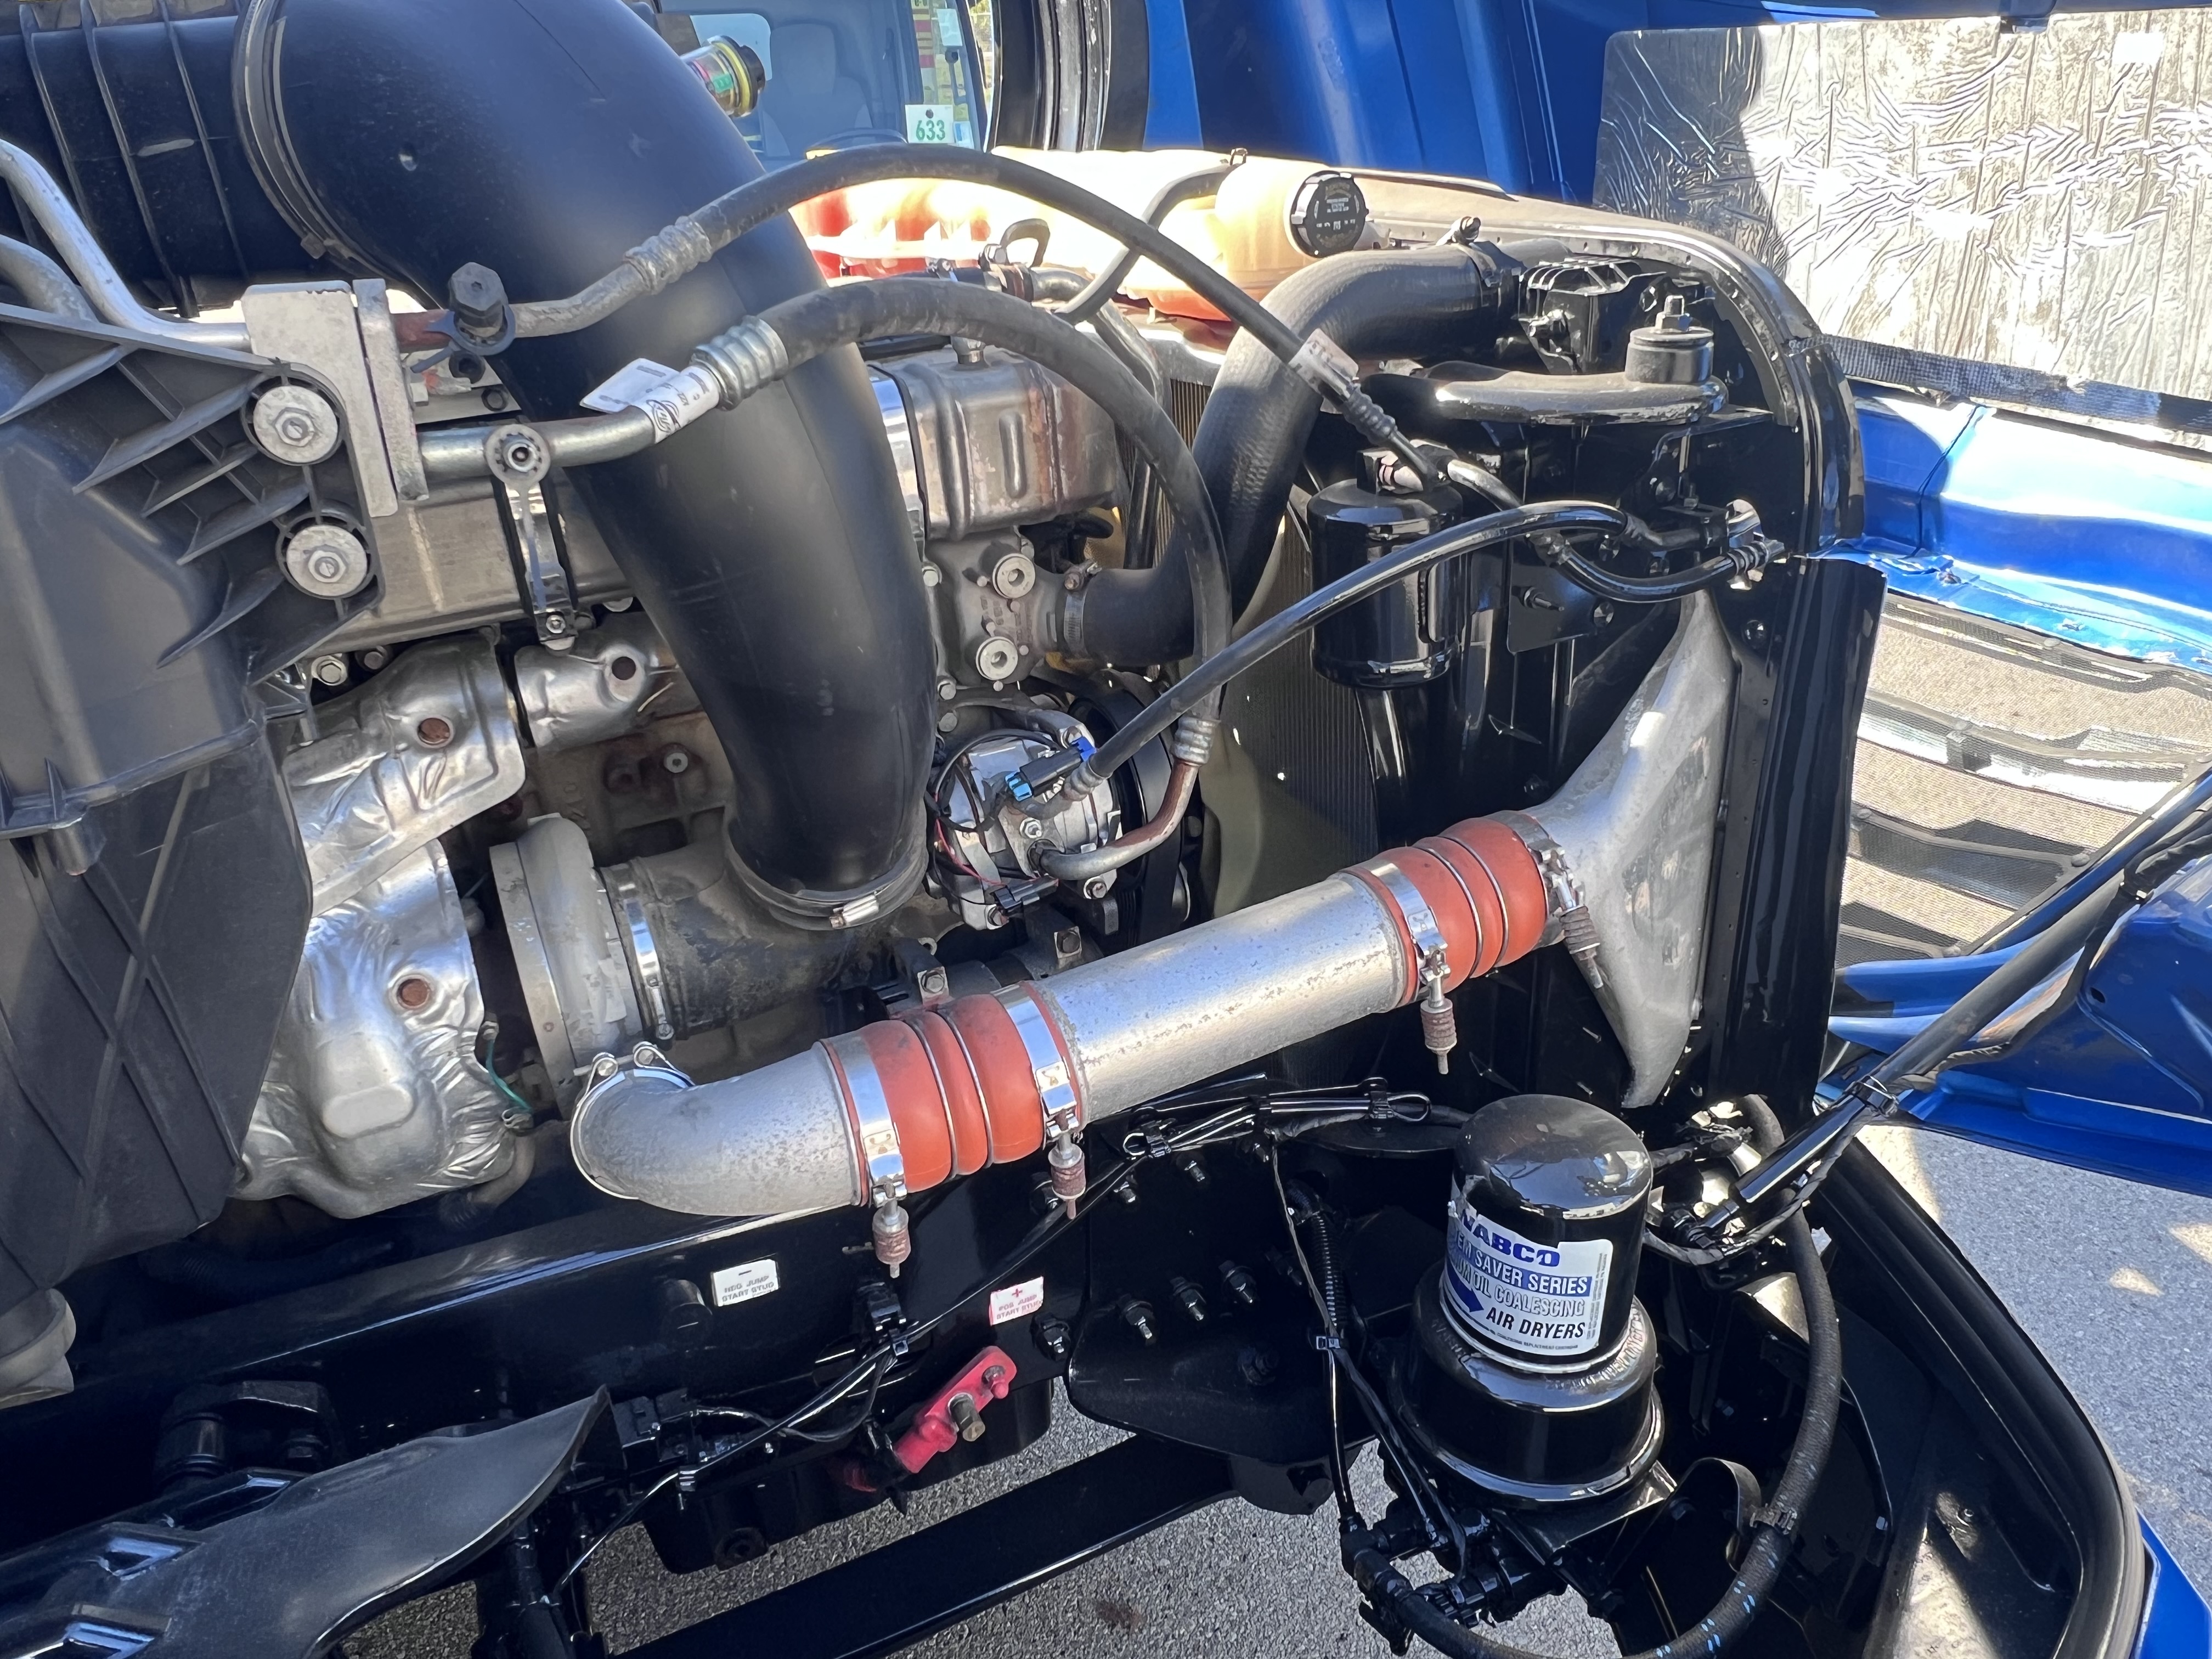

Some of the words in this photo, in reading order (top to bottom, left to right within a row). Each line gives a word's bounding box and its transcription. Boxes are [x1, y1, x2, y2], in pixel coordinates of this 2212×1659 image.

[916, 120, 946, 141] 633
[746, 1275, 769, 1287] JUMP
[1475, 1250, 1523, 1288] SAVER
[1528, 1273, 1588, 1295] SERIES
[721, 1289, 749, 1302] START
[751, 1281, 774, 1293] STUD
[1472, 1270, 1491, 1298] OIL
[1494, 1284, 1585, 1317] COALESCING
[996, 1307, 1020, 1320] START
[1486, 1306, 1515, 1330] AIR
[1519, 1319, 1585, 1339] DRYERS
